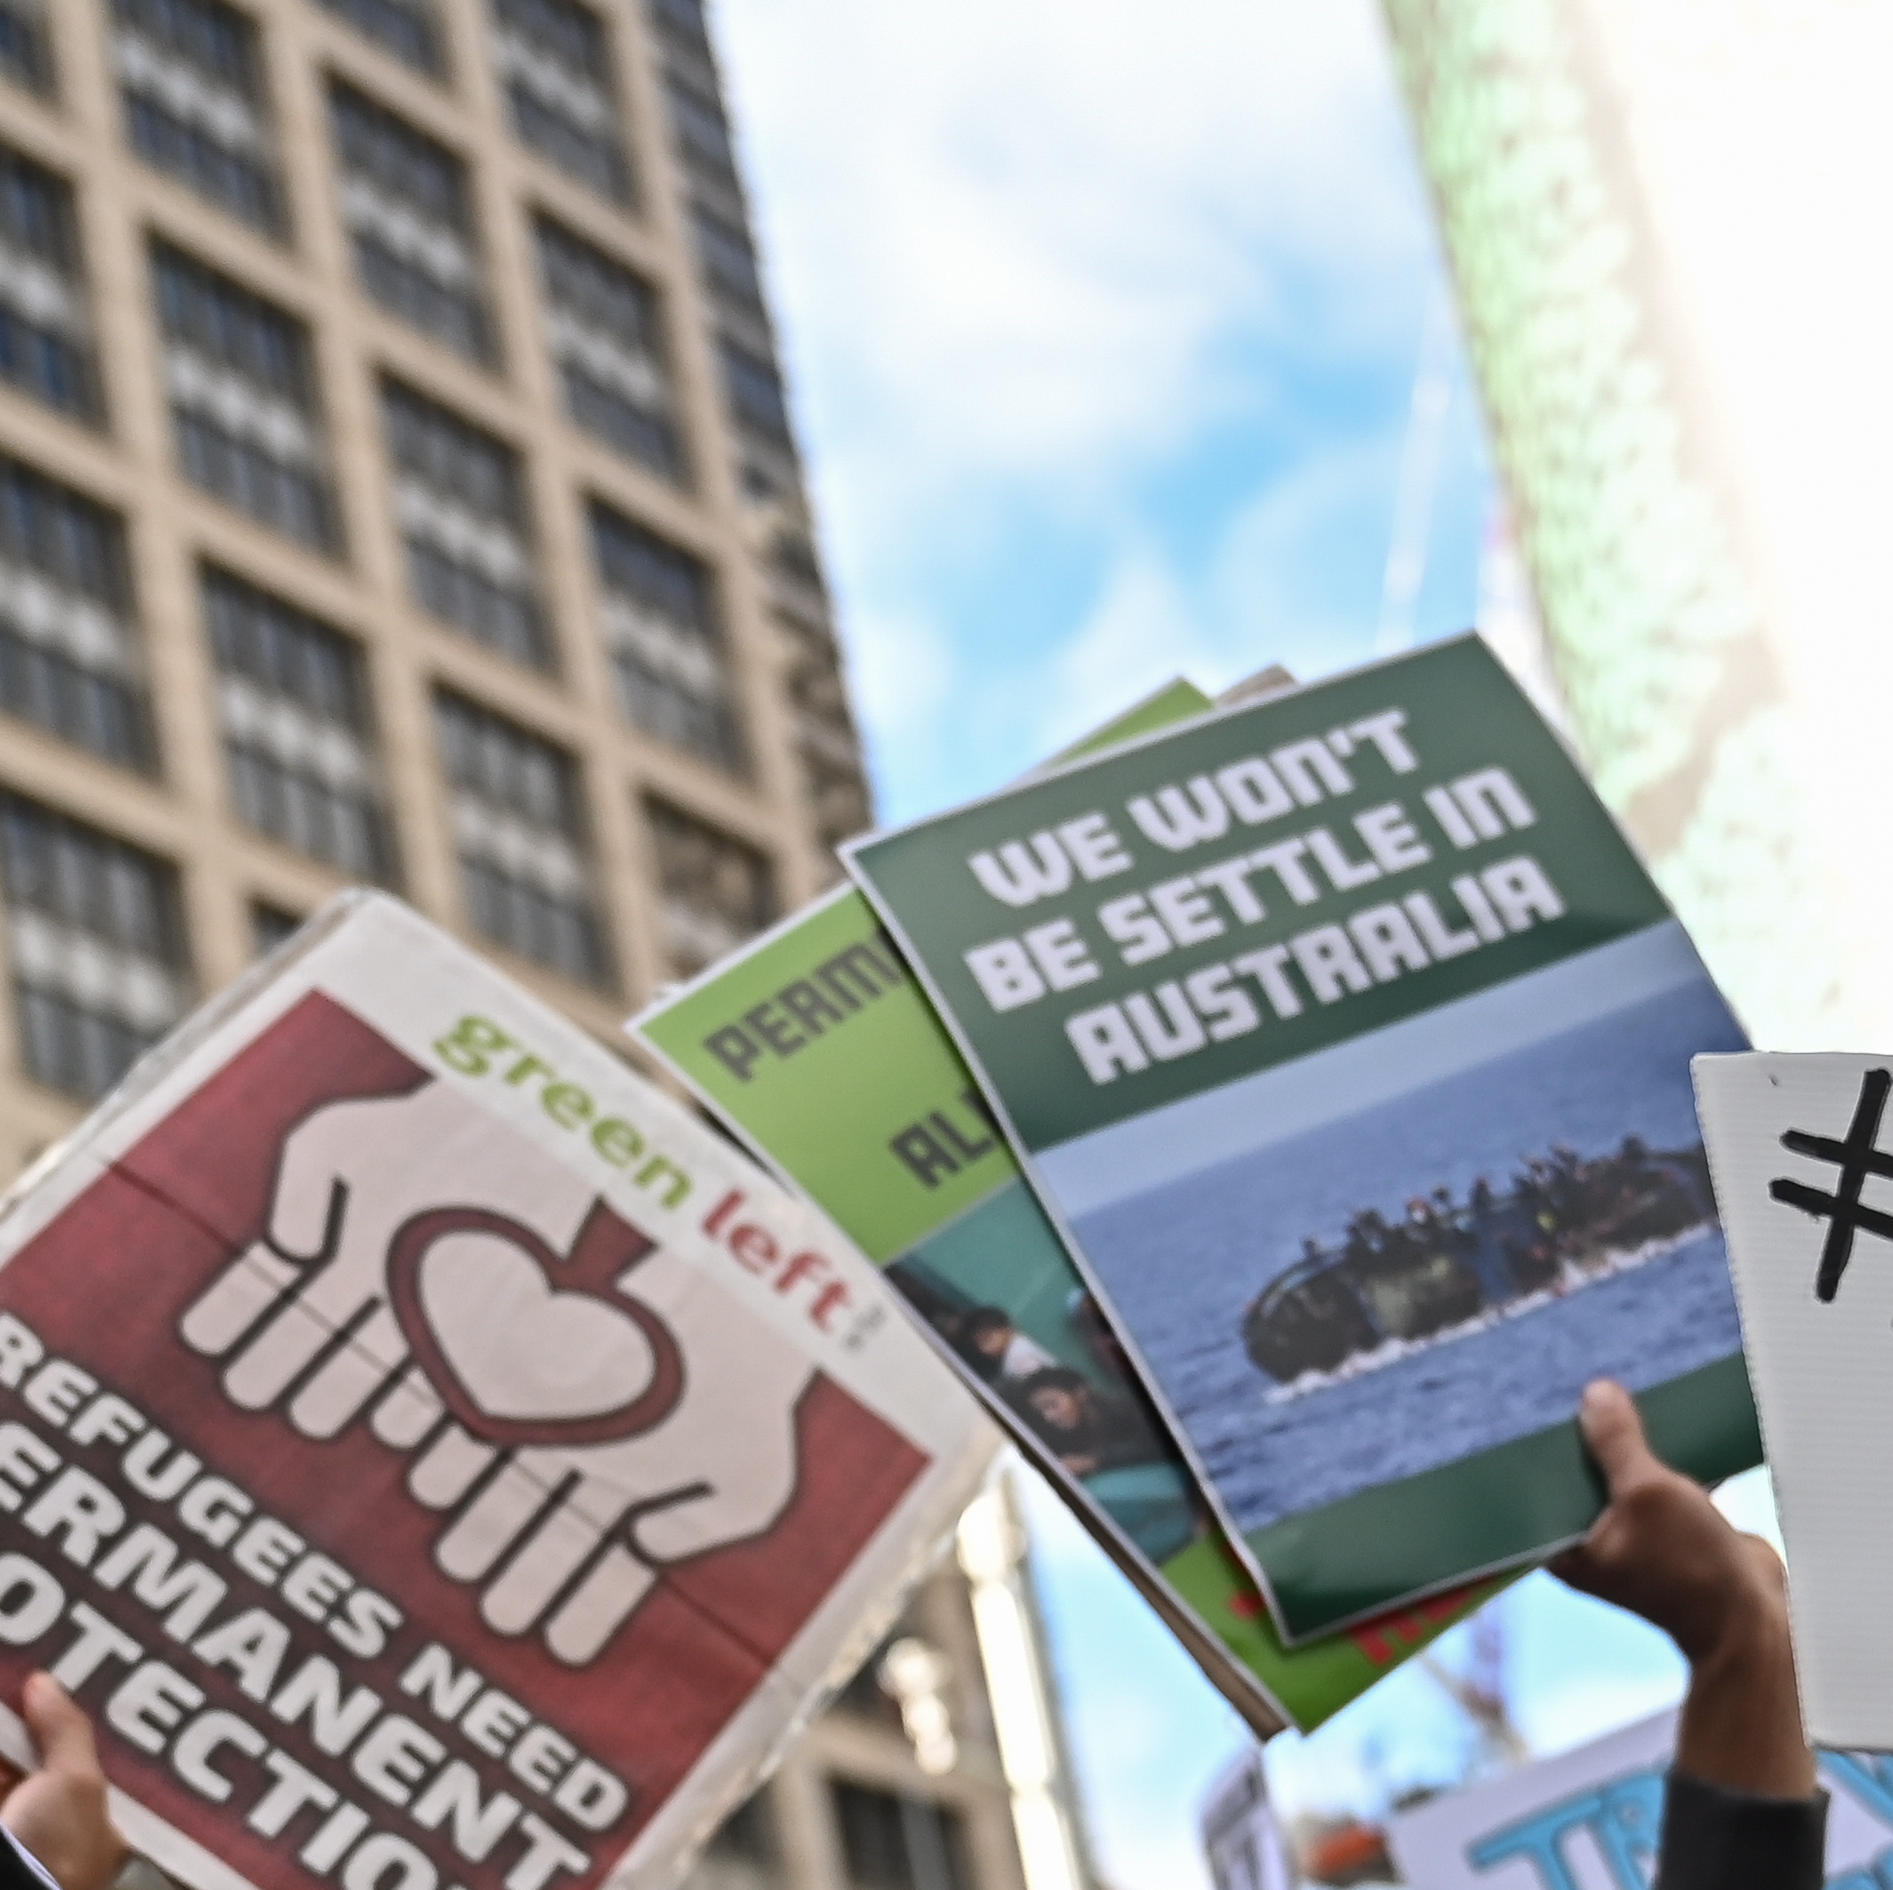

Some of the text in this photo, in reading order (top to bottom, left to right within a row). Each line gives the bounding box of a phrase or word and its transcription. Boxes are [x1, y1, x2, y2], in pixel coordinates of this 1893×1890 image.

[964, 765, 1538, 1013] BE SETTLE IN
[969, 708, 1420, 908] WE WON'T
[1064, 856, 1566, 1086] AUSTRALIA
[433, 1012, 856, 1334] green left
[398, 1640, 630, 1836] NEED
